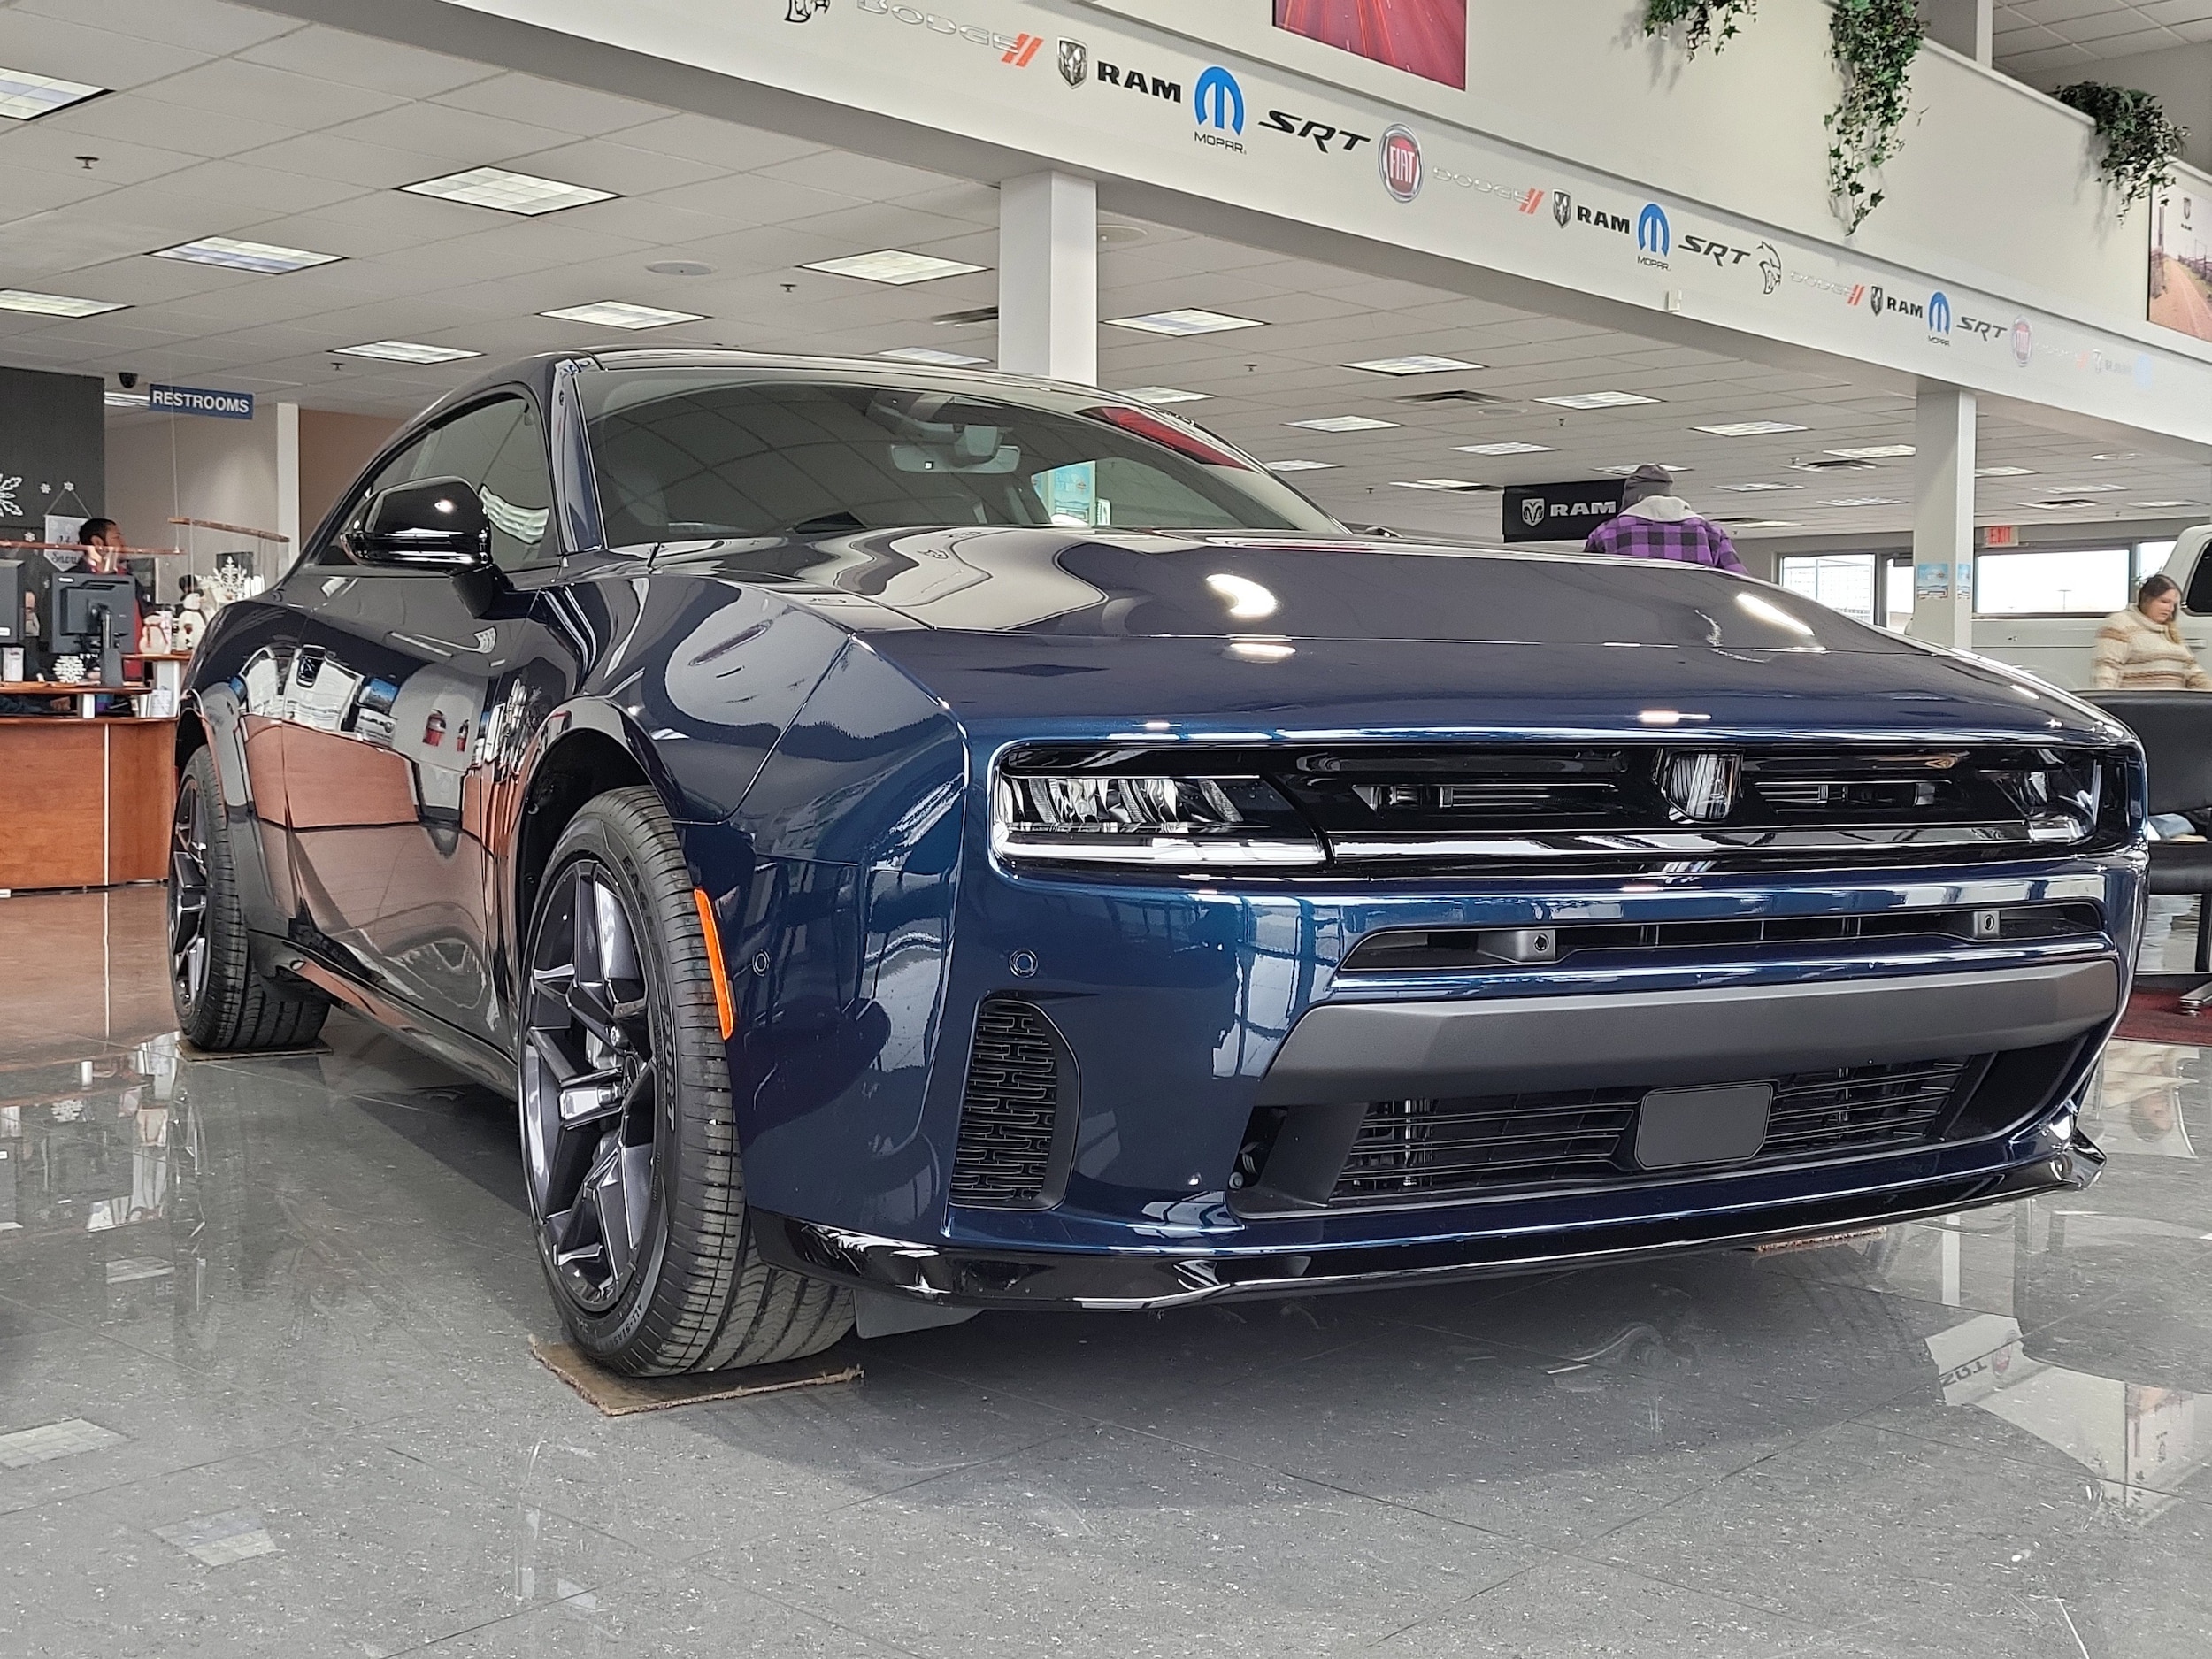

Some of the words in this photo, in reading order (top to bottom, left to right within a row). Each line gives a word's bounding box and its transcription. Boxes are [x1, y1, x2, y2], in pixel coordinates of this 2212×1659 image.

[1097, 60, 1182, 104] RAM
[1257, 110, 1371, 154] SRT
[1390, 145, 1416, 184] FIAT
[1577, 204, 1631, 234] RAM
[1678, 234, 1751, 267] SRT
[1886, 296, 1924, 319] RAM
[1956, 316, 2008, 342] SRT
[152, 390, 250, 413] RESTROOMS
[1549, 501, 1617, 517] RAM
